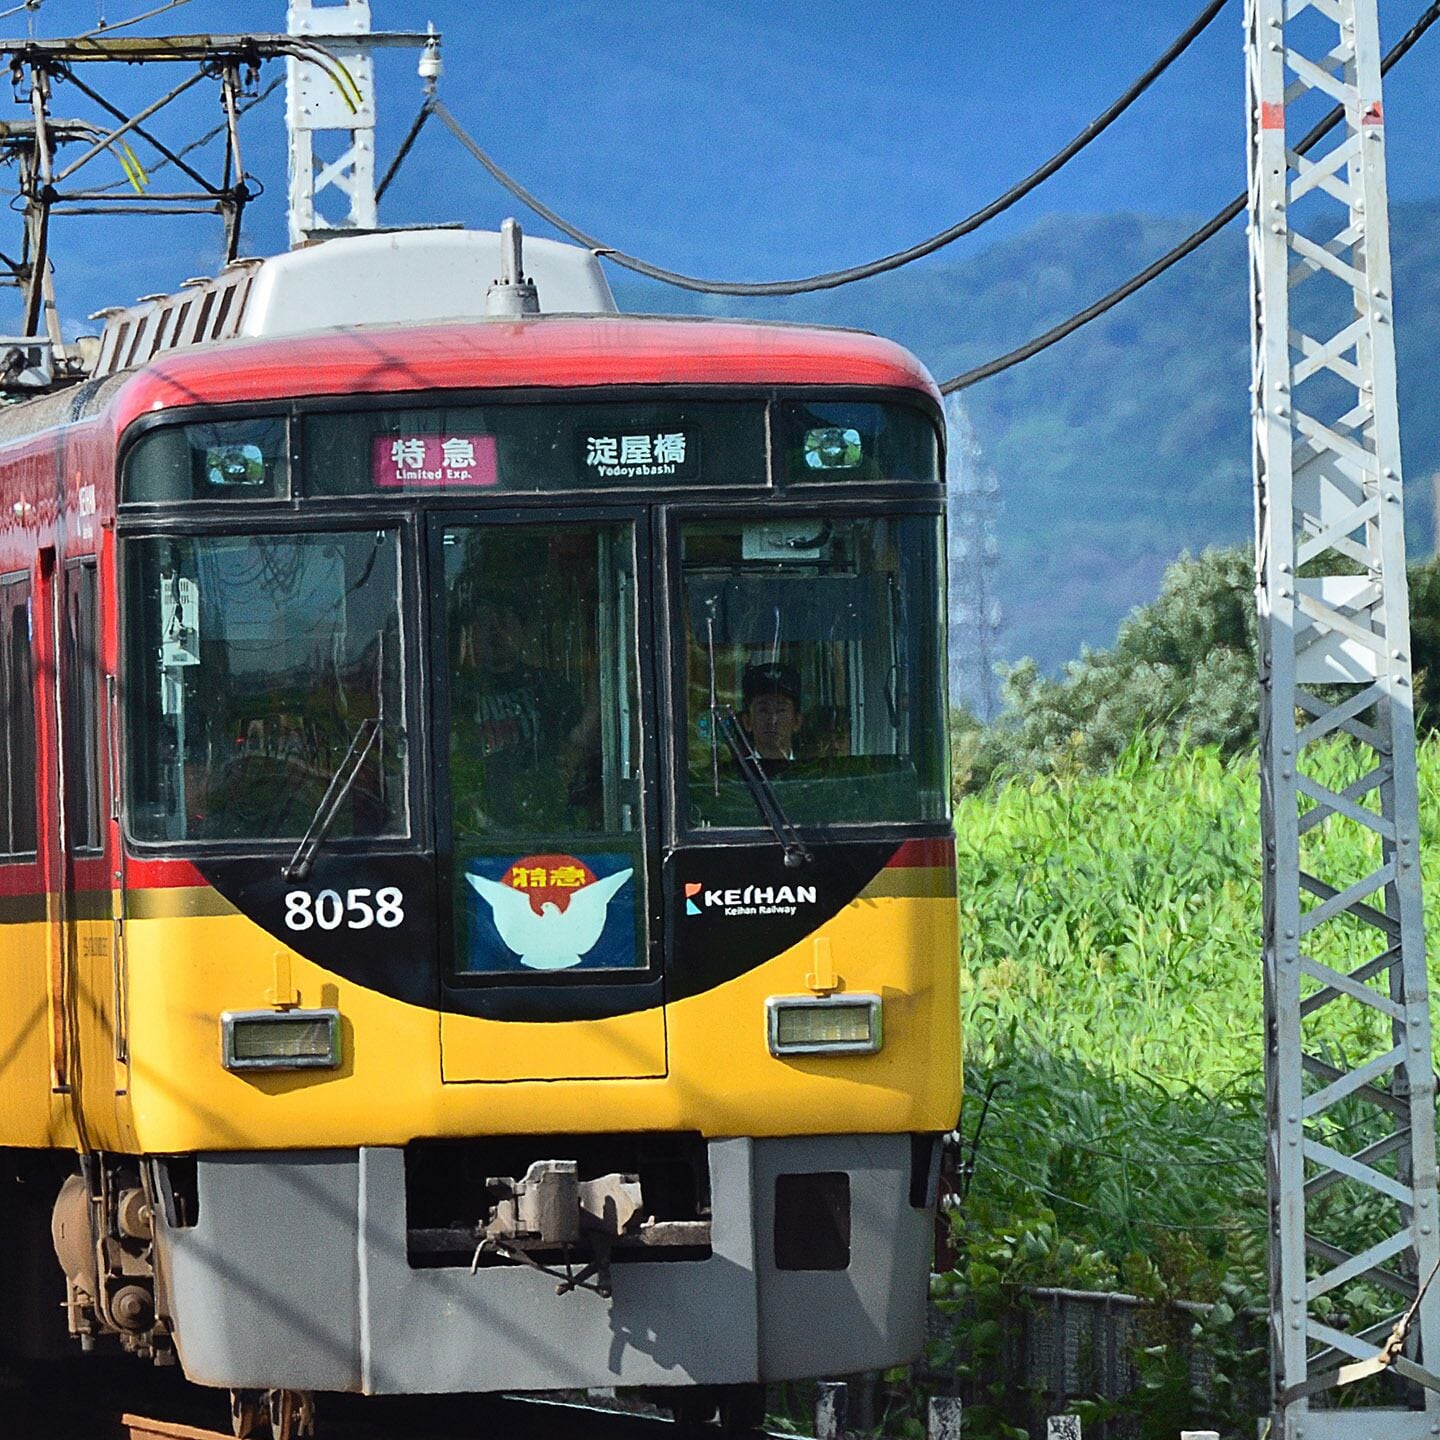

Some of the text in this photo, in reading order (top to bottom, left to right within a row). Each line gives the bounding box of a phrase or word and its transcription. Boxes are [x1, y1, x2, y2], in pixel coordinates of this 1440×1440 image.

[391, 438, 477, 468] 特急
[586, 433, 686, 466] 淀屋橋
[396, 469, 472, 480] Limited Exp.
[598, 464, 676, 477] Yodoyabashi
[512, 866, 586, 887] 特急
[704, 885, 817, 906] KEIHAN
[285, 887, 404, 931] 8058
[725, 906, 797, 915] Keihan Railway
